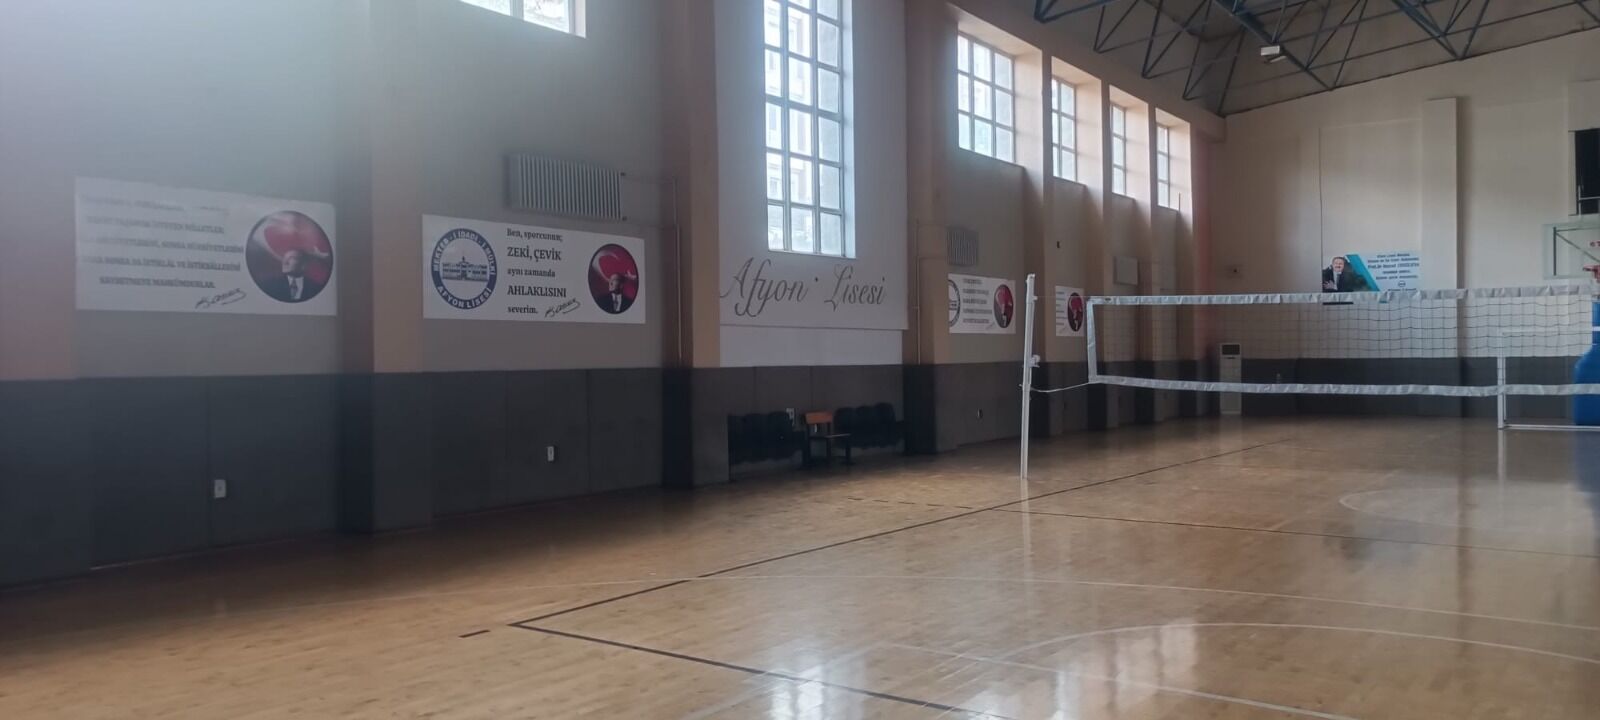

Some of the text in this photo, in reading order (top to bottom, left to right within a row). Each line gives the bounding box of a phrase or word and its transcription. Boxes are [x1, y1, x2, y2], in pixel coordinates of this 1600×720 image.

[507, 228, 523, 238] Ben,
[507, 245, 562, 262] ZEKİ, ÇEVİK
[507, 268, 555, 277] aynı zamanda
[507, 285, 567, 298] AHLAKLISINI
[720, 257, 808, 317] Afyon
[824, 264, 887, 312] Lisesi
[507, 305, 538, 314] severim.
